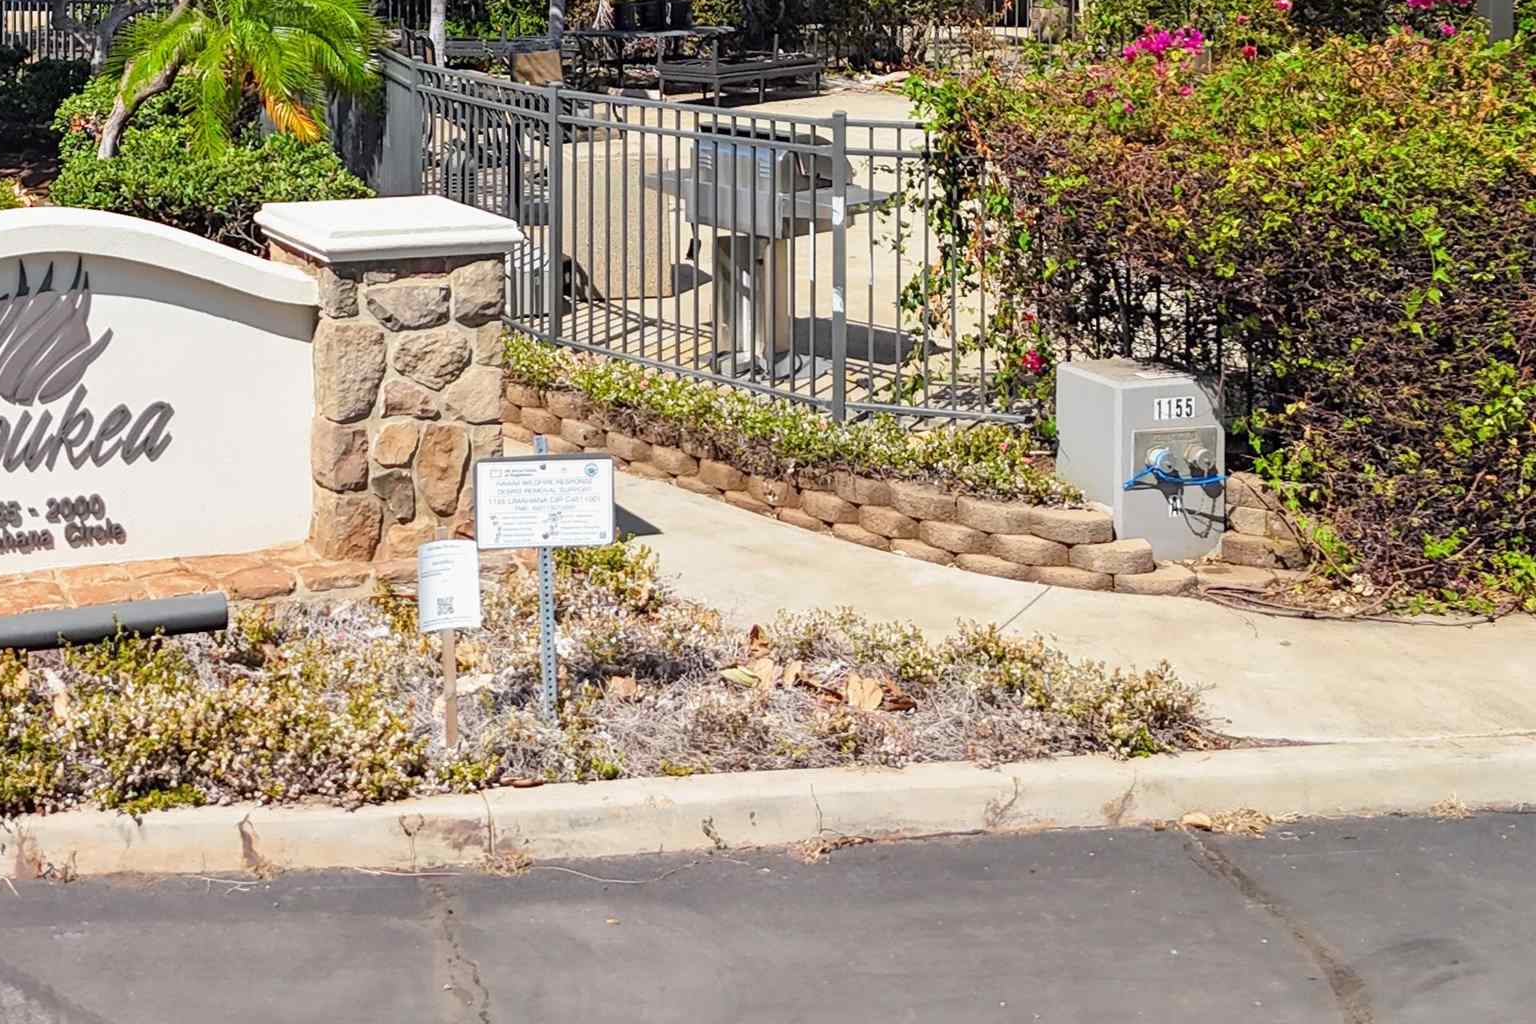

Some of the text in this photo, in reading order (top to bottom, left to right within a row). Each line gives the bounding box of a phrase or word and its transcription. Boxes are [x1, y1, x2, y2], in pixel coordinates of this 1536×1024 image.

[1156, 397, 1193, 420] 1155
[45, 493, 106, 523] 2000
[64, 516, 128, 548] Circle
